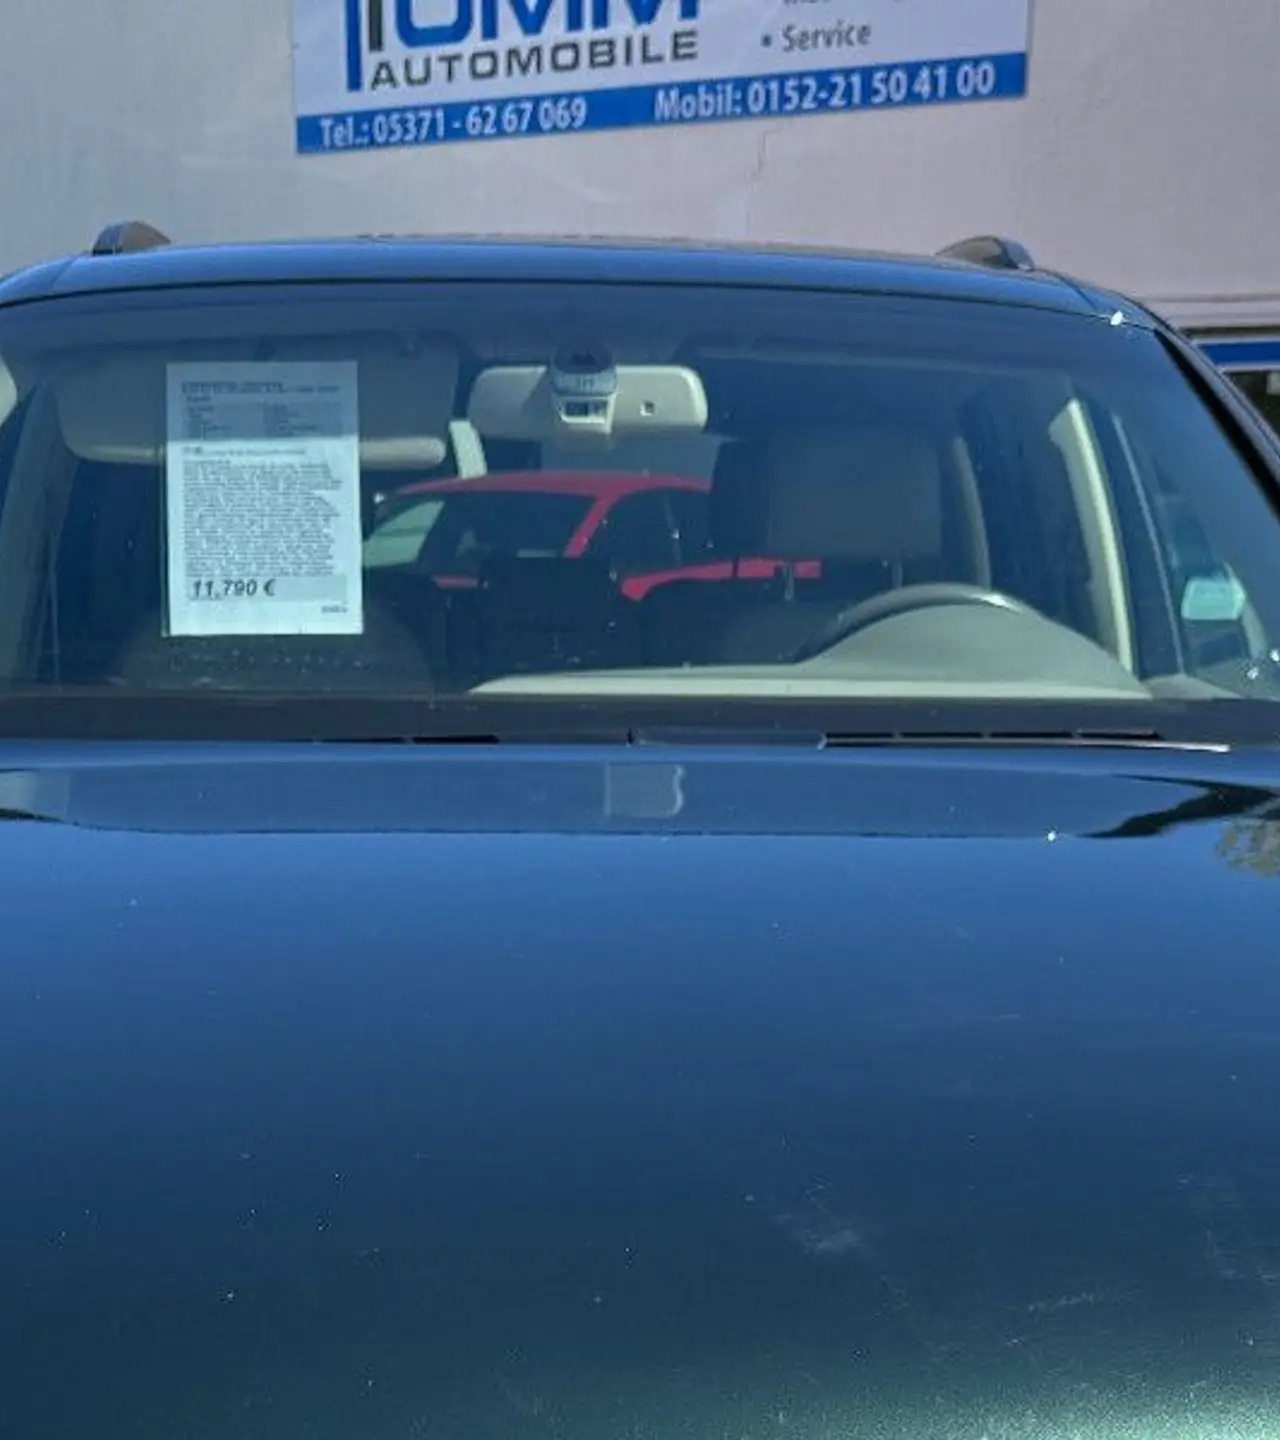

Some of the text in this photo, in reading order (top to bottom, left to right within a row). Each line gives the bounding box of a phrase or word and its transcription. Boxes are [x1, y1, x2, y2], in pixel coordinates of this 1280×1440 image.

[781, 20, 871, 52] Service
[370, 29, 699, 91] AUTOMOBILE
[654, 83, 742, 122] Mobil:
